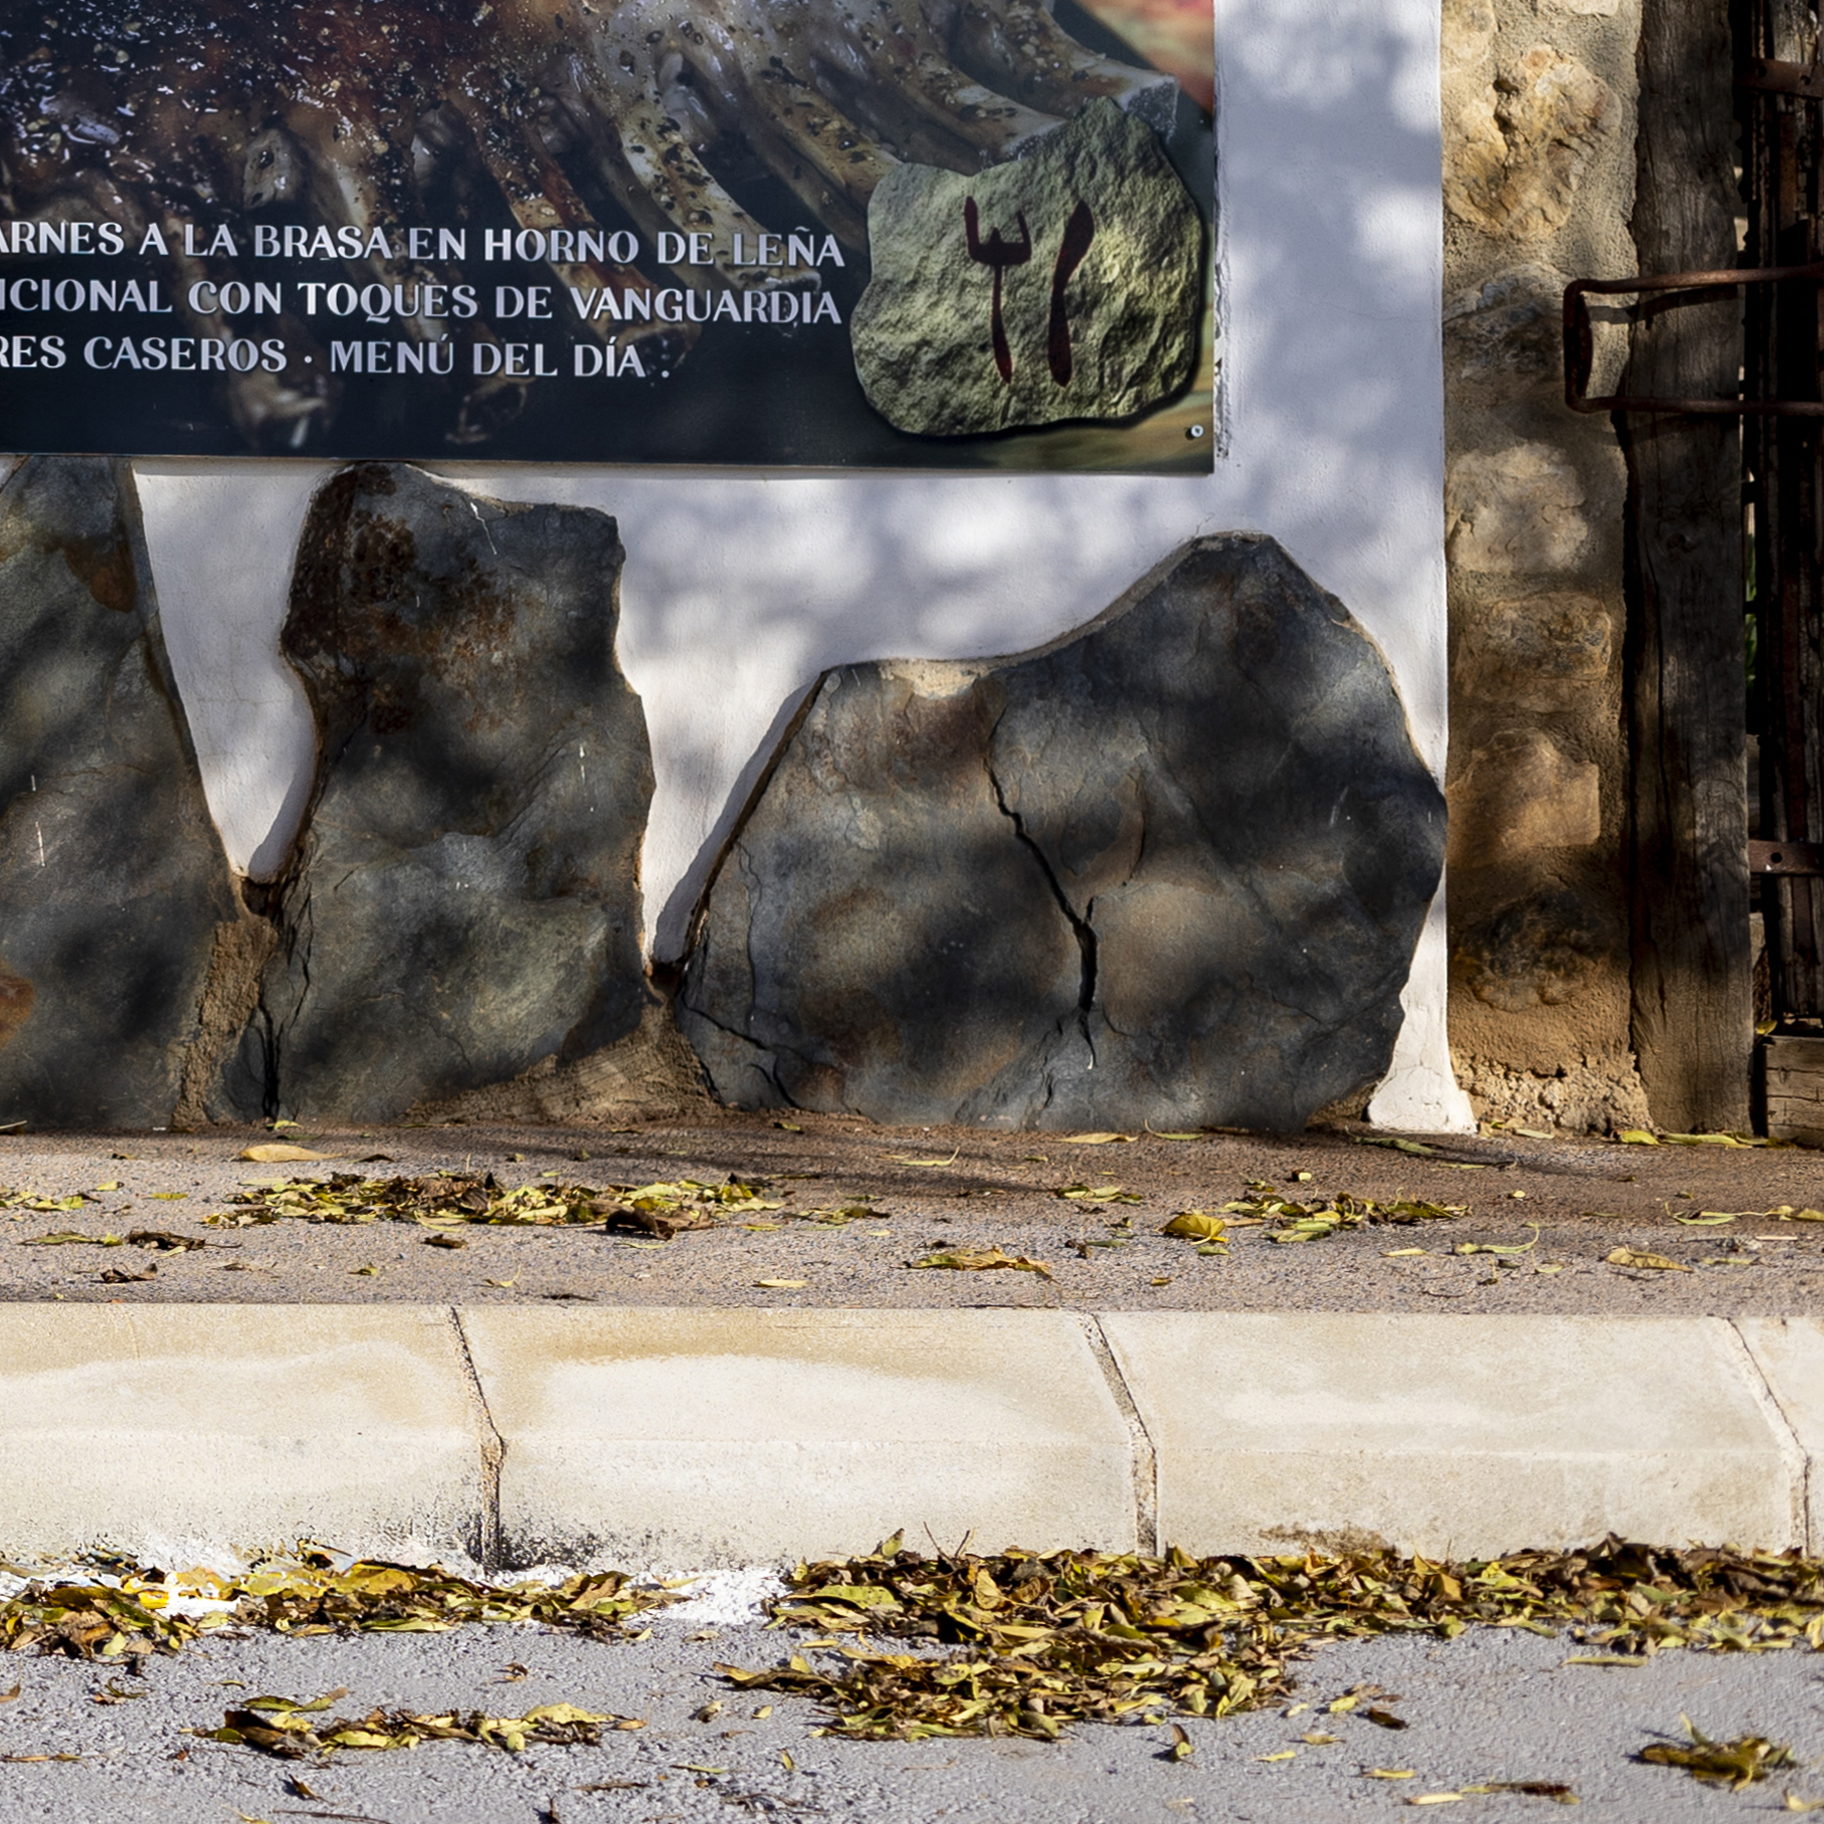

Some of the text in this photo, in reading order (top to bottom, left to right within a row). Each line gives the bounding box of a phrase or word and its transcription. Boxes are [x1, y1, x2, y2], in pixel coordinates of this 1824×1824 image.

[139, 222, 168, 256] A
[184, 224, 238, 256] LA
[254, 225, 393, 259] BRASA
[409, 227, 466, 260] EN
[484, 229, 640, 264] HORNO
[657, 231, 714, 265] DE
[733, 226, 845, 267] LEÑA
[188, 281, 281, 315] CON
[297, 282, 479, 323] TOQUES
[495, 286, 553, 318] DE
[570, 287, 843, 324] VANGUARDIA
[83, 336, 288, 372] CASEROS
[331, 333, 454, 374] MENÚ
[473, 342, 558, 376] DEL
[574, 336, 646, 377] DÍA
